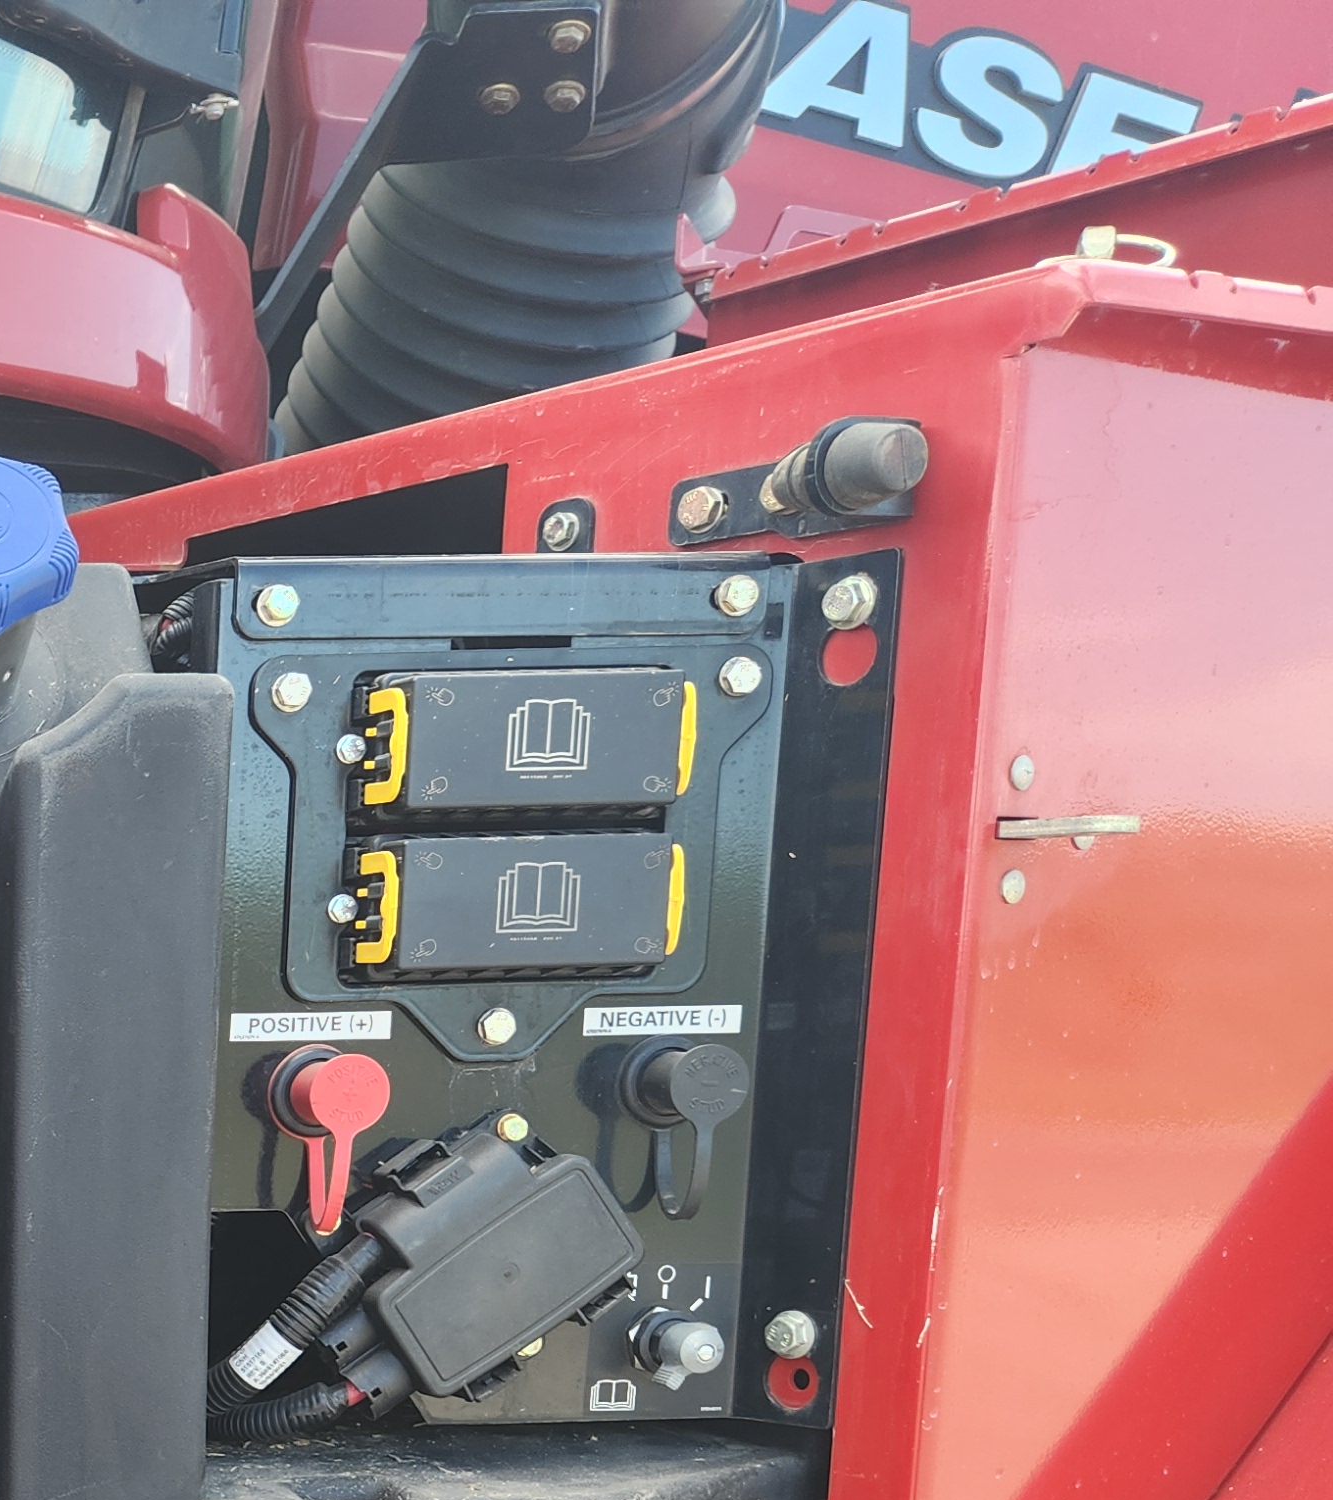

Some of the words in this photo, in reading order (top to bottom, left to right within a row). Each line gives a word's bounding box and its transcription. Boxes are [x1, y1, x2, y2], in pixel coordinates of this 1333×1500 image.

[761, 0, 1200, 179] ASE
[248, 1015, 343, 1034] POSITIVE
[600, 1009, 702, 1028] NEGATIVE
[327, 1063, 379, 1088] POSITIVE
[328, 1107, 365, 1124] STUD
